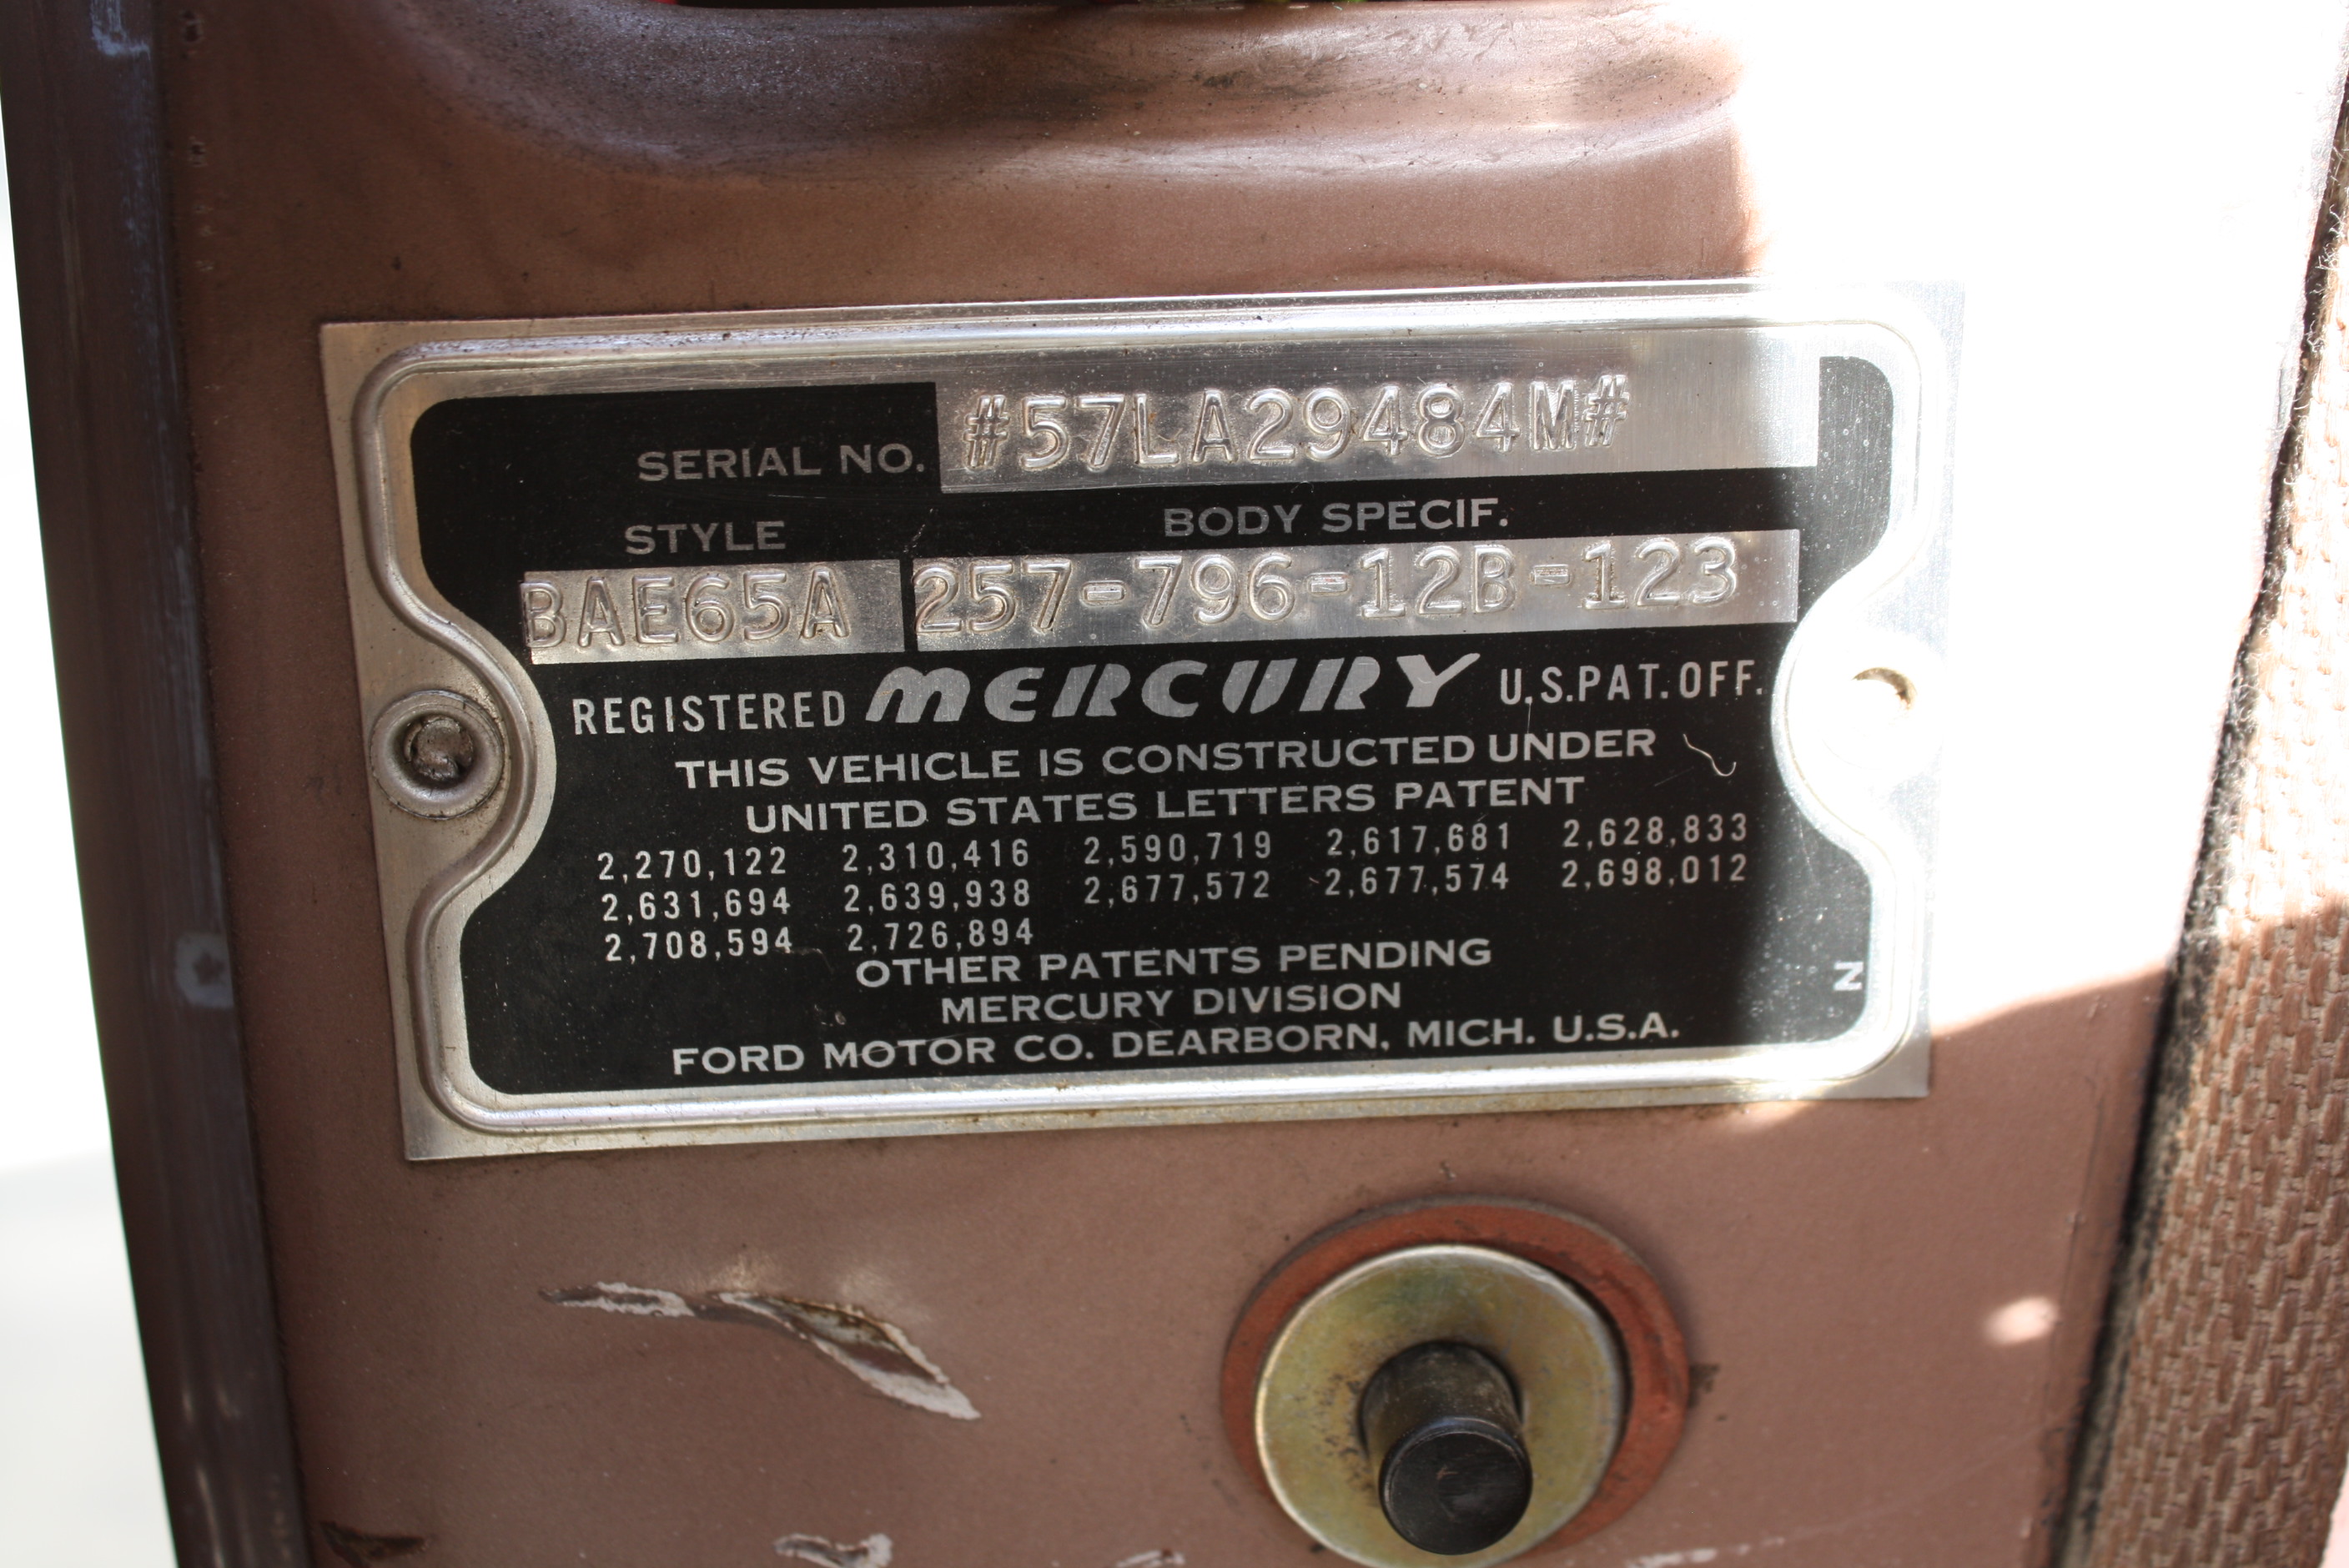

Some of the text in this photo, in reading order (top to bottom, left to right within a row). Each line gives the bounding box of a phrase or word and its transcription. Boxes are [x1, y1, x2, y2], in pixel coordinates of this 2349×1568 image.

[963, 372, 1631, 472] #57LA29484M#
[637, 443, 925, 481] SERIAL NO.
[624, 520, 787, 555] STYLE
[1164, 497, 1508, 538] BODY SPECIF.
[521, 570, 851, 649] BAE65A
[572, 691, 846, 736] REGISTERED
[865, 652, 1481, 724] MERCURY
[675, 728, 1657, 789] THIS VEHICLE IS CONSTRUCTED UNDER
[746, 776, 1586, 833] UNITED STATES LETTERS PATENT
[597, 812, 1748, 882] 2,270,122 2,310,416 2,590,719 2,617,681 2,628,833
[601, 854, 1747, 923] 2,631,694 2,639,938 2,677,572 2,677,574 2,698,012
[605, 918, 1034, 964] 2,708,594 2,726,894
[856, 937, 1492, 988] OTHER PATENTS PENDING
[943, 982, 1401, 1024] MERCURY DIVISION
[672, 1012, 1680, 1076] FORD MOTOR CO. DEARBORN, MICH. U.S.A.
